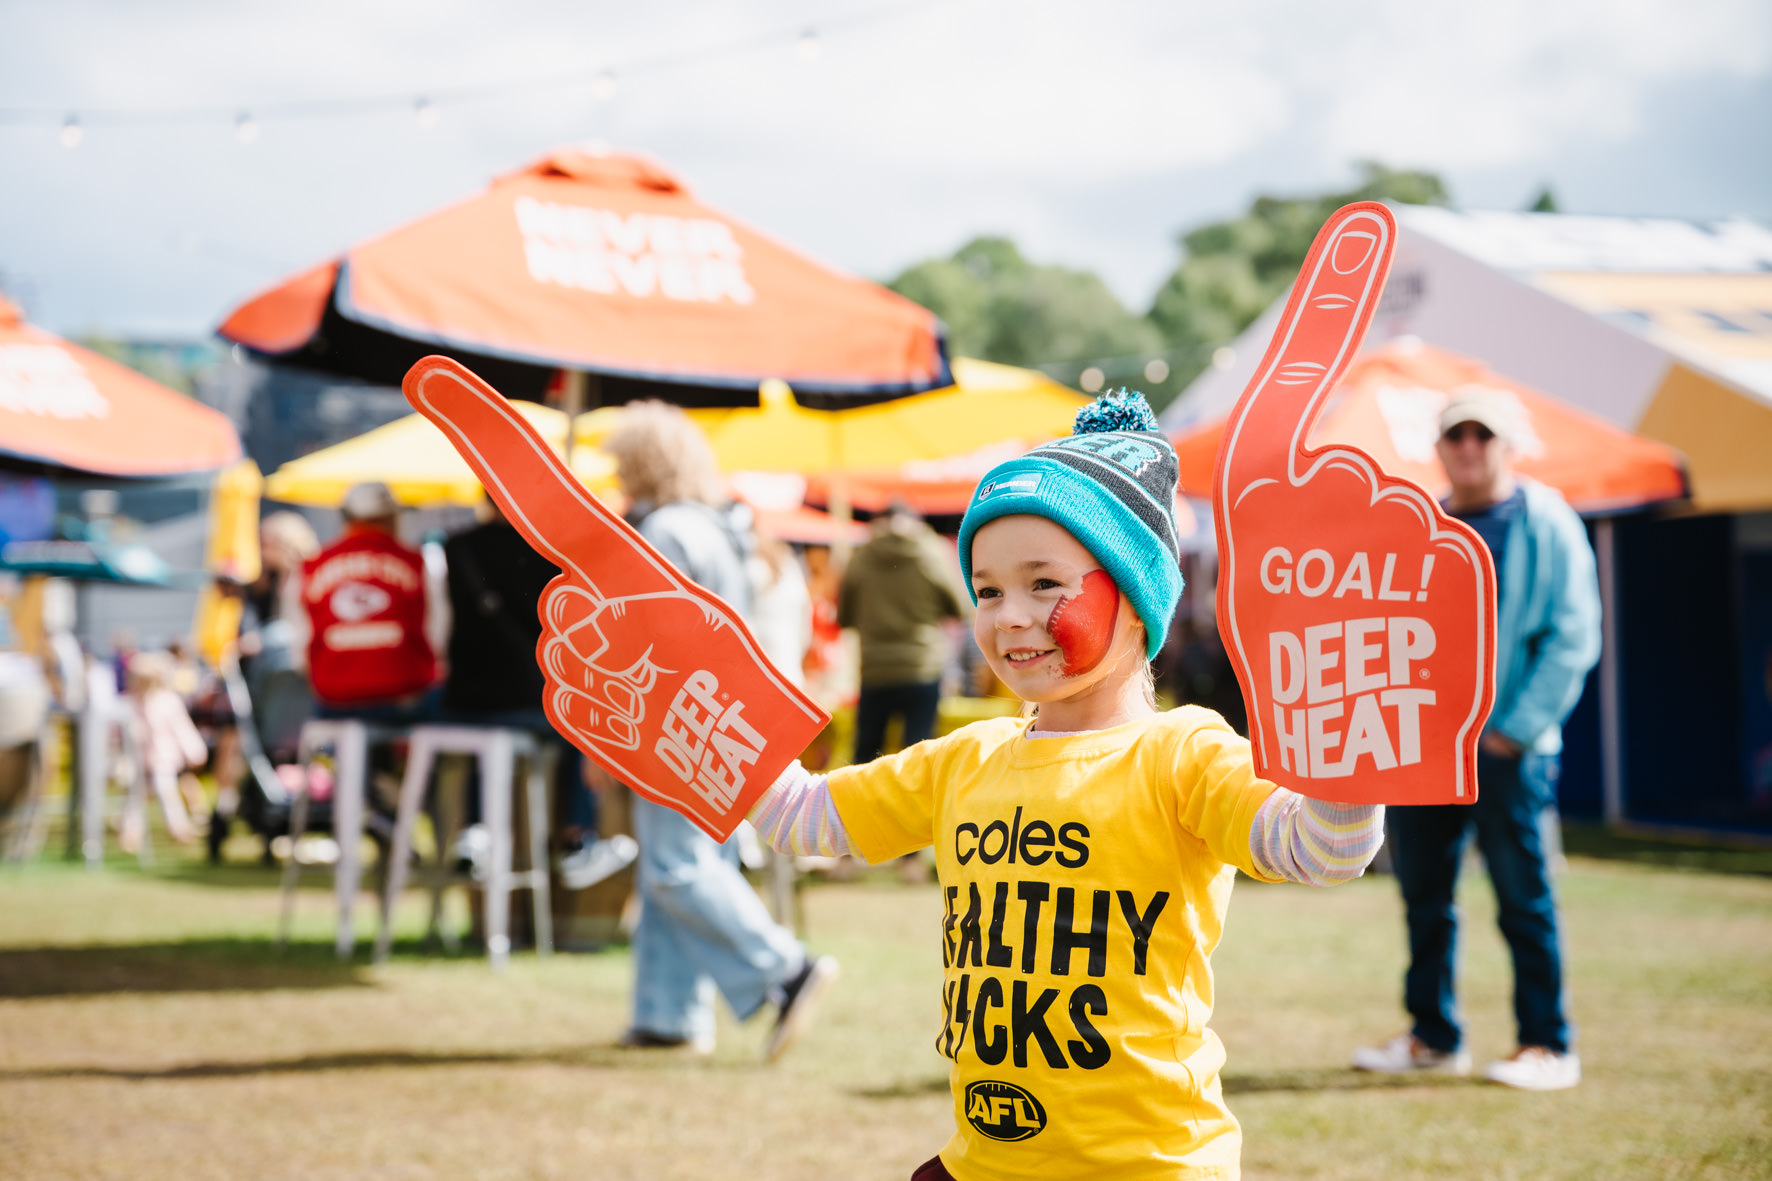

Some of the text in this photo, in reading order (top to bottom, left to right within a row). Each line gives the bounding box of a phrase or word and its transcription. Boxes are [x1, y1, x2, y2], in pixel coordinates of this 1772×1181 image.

[1259, 546, 1436, 602] GOAL!
[1269, 616, 1437, 705] DEEP
[654, 669, 725, 784] DEEP
[688, 699, 768, 817] HEAT
[1273, 688, 1437, 779] HEAT
[955, 806, 1091, 869] coles
[967, 1092, 1042, 1129] AFL
